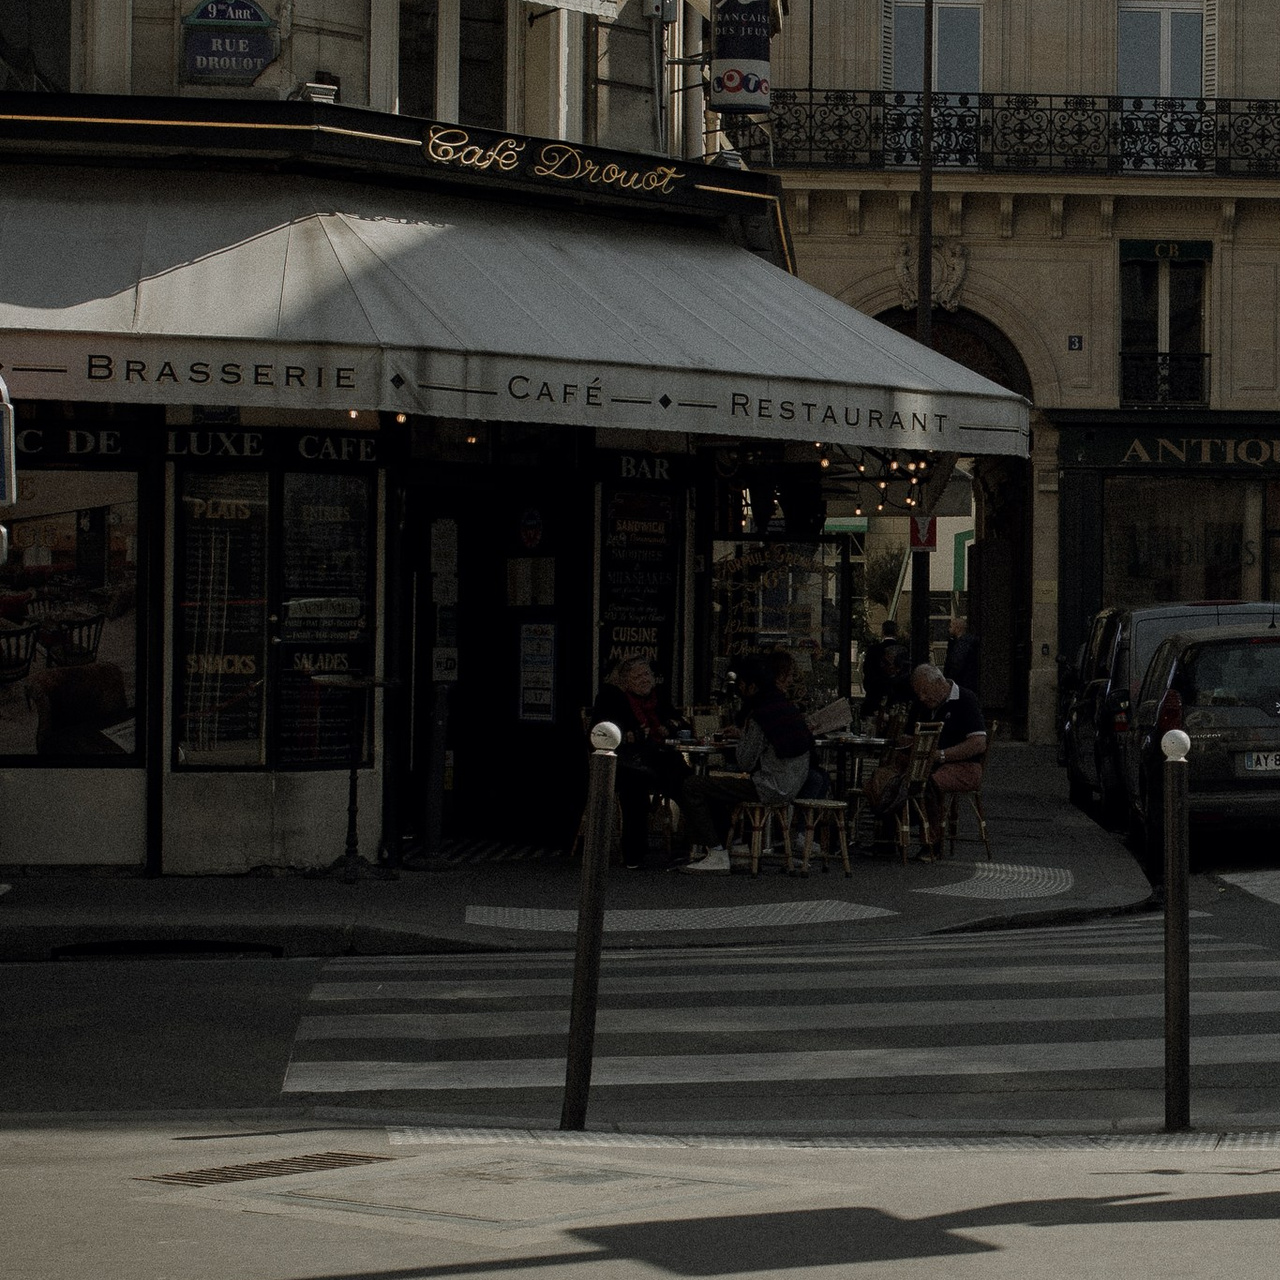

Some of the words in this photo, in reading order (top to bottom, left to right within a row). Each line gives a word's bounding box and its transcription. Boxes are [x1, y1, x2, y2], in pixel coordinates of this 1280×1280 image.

[716, 27, 735, 35] DES
[741, 26, 768, 37] JEUX
[211, 38, 249, 52] RUE
[195, 55, 265, 70] DROUOT
[428, 125, 526, 170] Café
[534, 144, 685, 195] Drouot
[1155, 243, 1179, 257] CB
[1071, 337, 1079, 349] 3
[87, 354, 357, 389] BRASSERIE
[508, 376, 602, 407] CAFÉ
[731, 392, 948, 433] RESTAURANT
[68, 429, 124, 455] DE
[168, 430, 267, 458] LUXE
[300, 435, 379, 462] CAFE
[621, 456, 669, 480] BAR
[193, 501, 251, 520] PLATS
[612, 625, 658, 643] CUISINE
[293, 653, 349, 672] SALADES
[609, 645, 659, 662] MAISON
[187, 653, 257, 675] SNACKS
